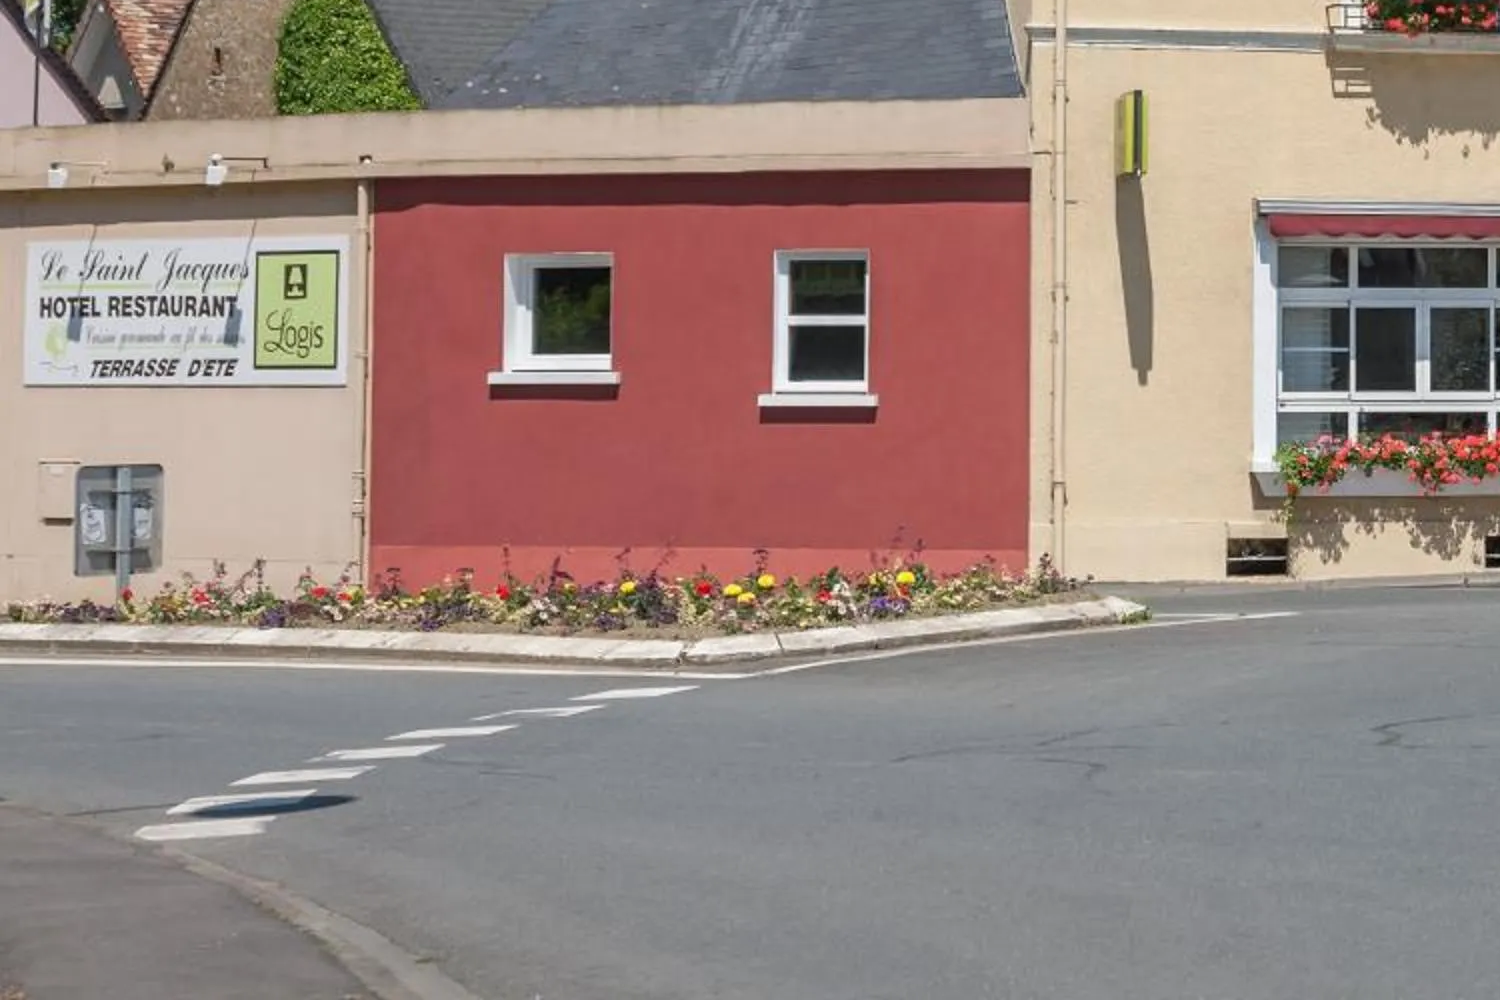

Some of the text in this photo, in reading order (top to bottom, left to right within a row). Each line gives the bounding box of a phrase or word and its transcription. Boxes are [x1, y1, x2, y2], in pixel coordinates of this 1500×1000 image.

[41, 246, 249, 295] Le Saint Jacques
[40, 294, 239, 319] HOTEL RESTAURANT
[263, 307, 325, 359] Logis
[90, 357, 240, 379] TERRASSE D'ETE
